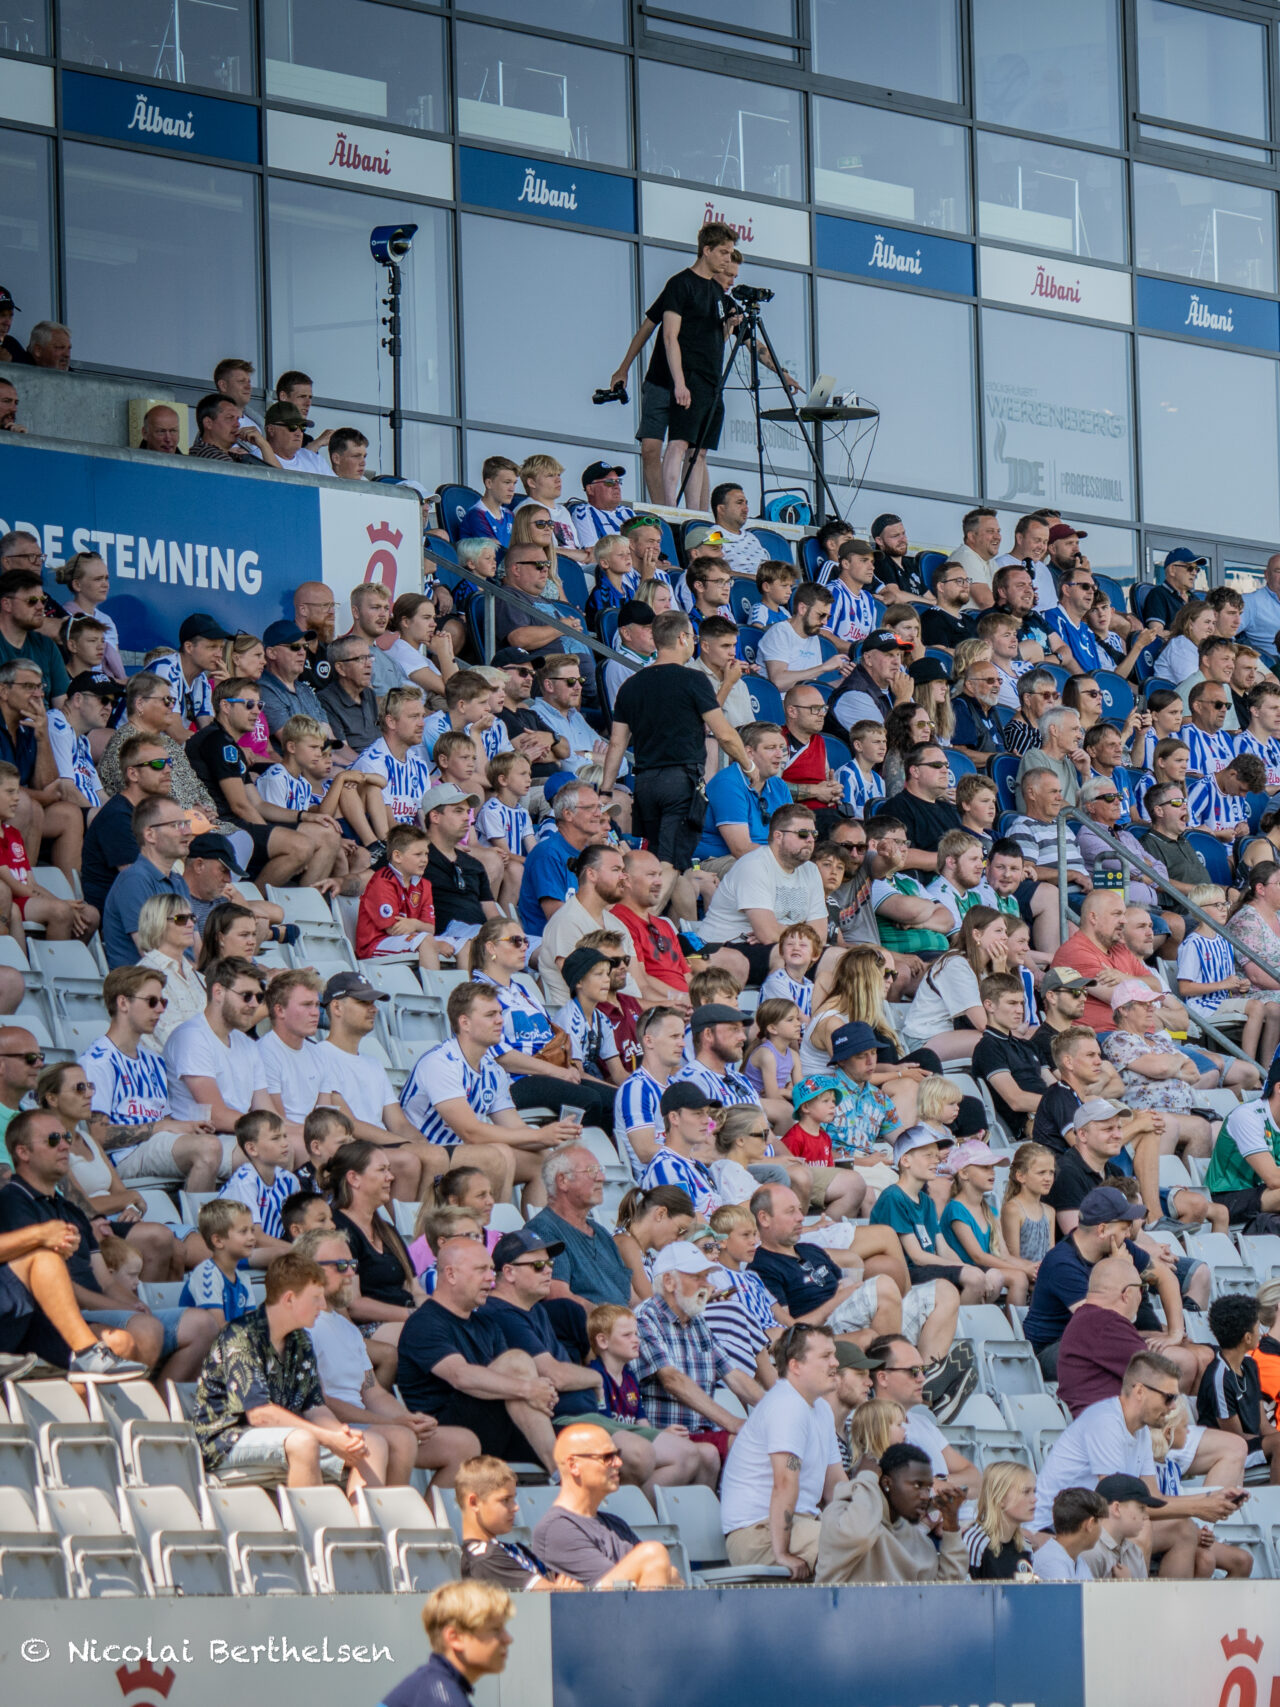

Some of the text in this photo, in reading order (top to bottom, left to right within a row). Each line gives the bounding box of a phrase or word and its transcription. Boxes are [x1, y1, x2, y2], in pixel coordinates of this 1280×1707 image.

[128, 97, 195, 140] Albani
[328, 136, 391, 176] Albani
[518, 171, 578, 211] Albani
[868, 238, 923, 275] Albani
[1030, 269, 1082, 304] Albani
[1184, 298, 1234, 333] Albani
